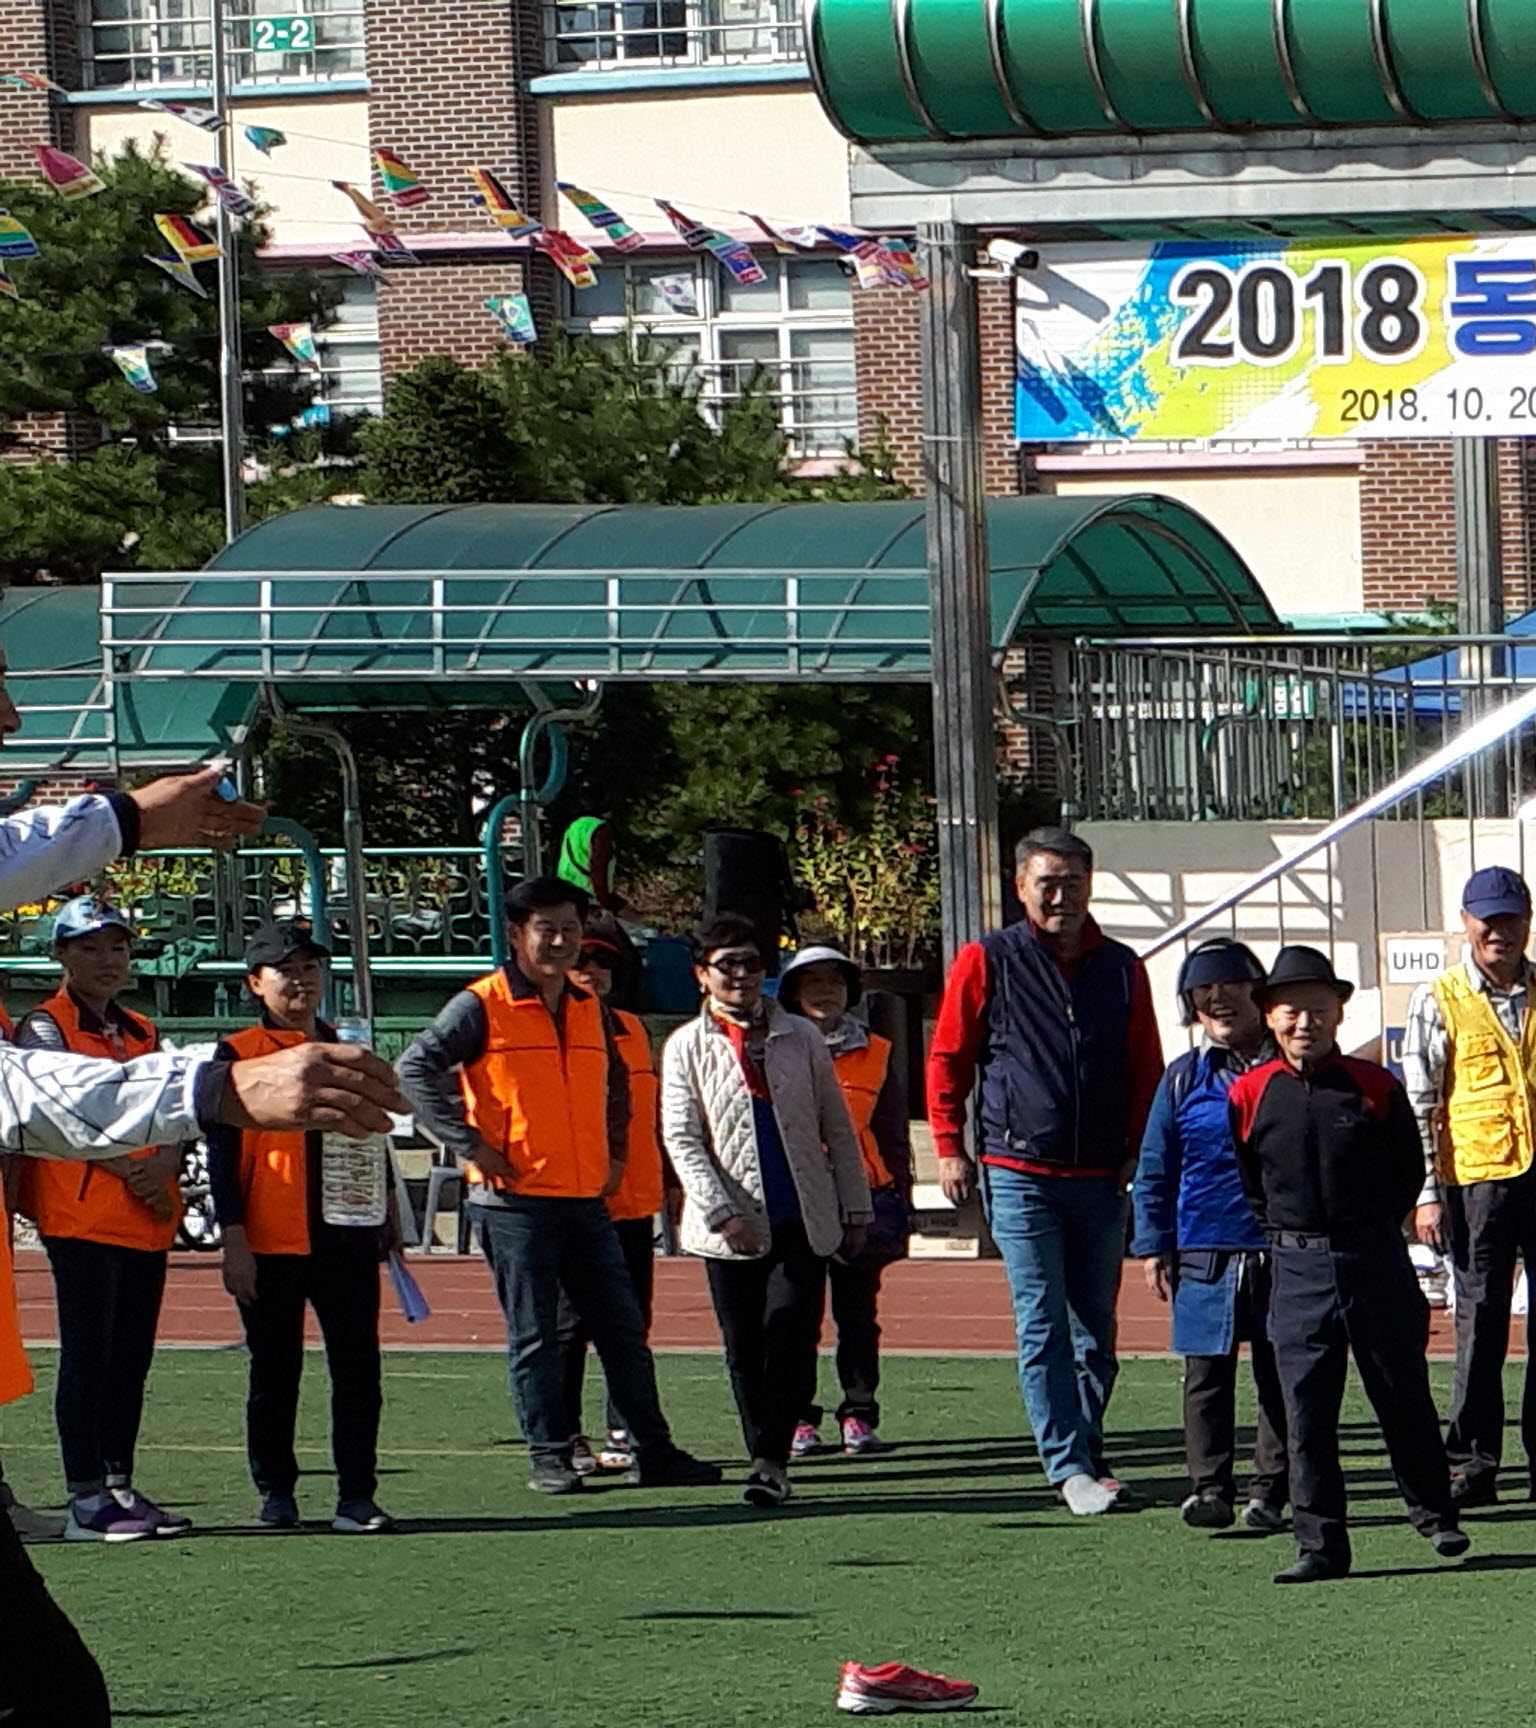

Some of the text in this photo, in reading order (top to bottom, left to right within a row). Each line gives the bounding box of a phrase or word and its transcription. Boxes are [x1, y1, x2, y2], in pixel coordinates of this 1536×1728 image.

[255, 19, 310, 49] 2-2
[1177, 263, 1421, 360] 2018
[1340, 387, 1428, 422] 2018.
[1447, 386, 1491, 420] 10.
[1393, 952, 1440, 970] UHD
